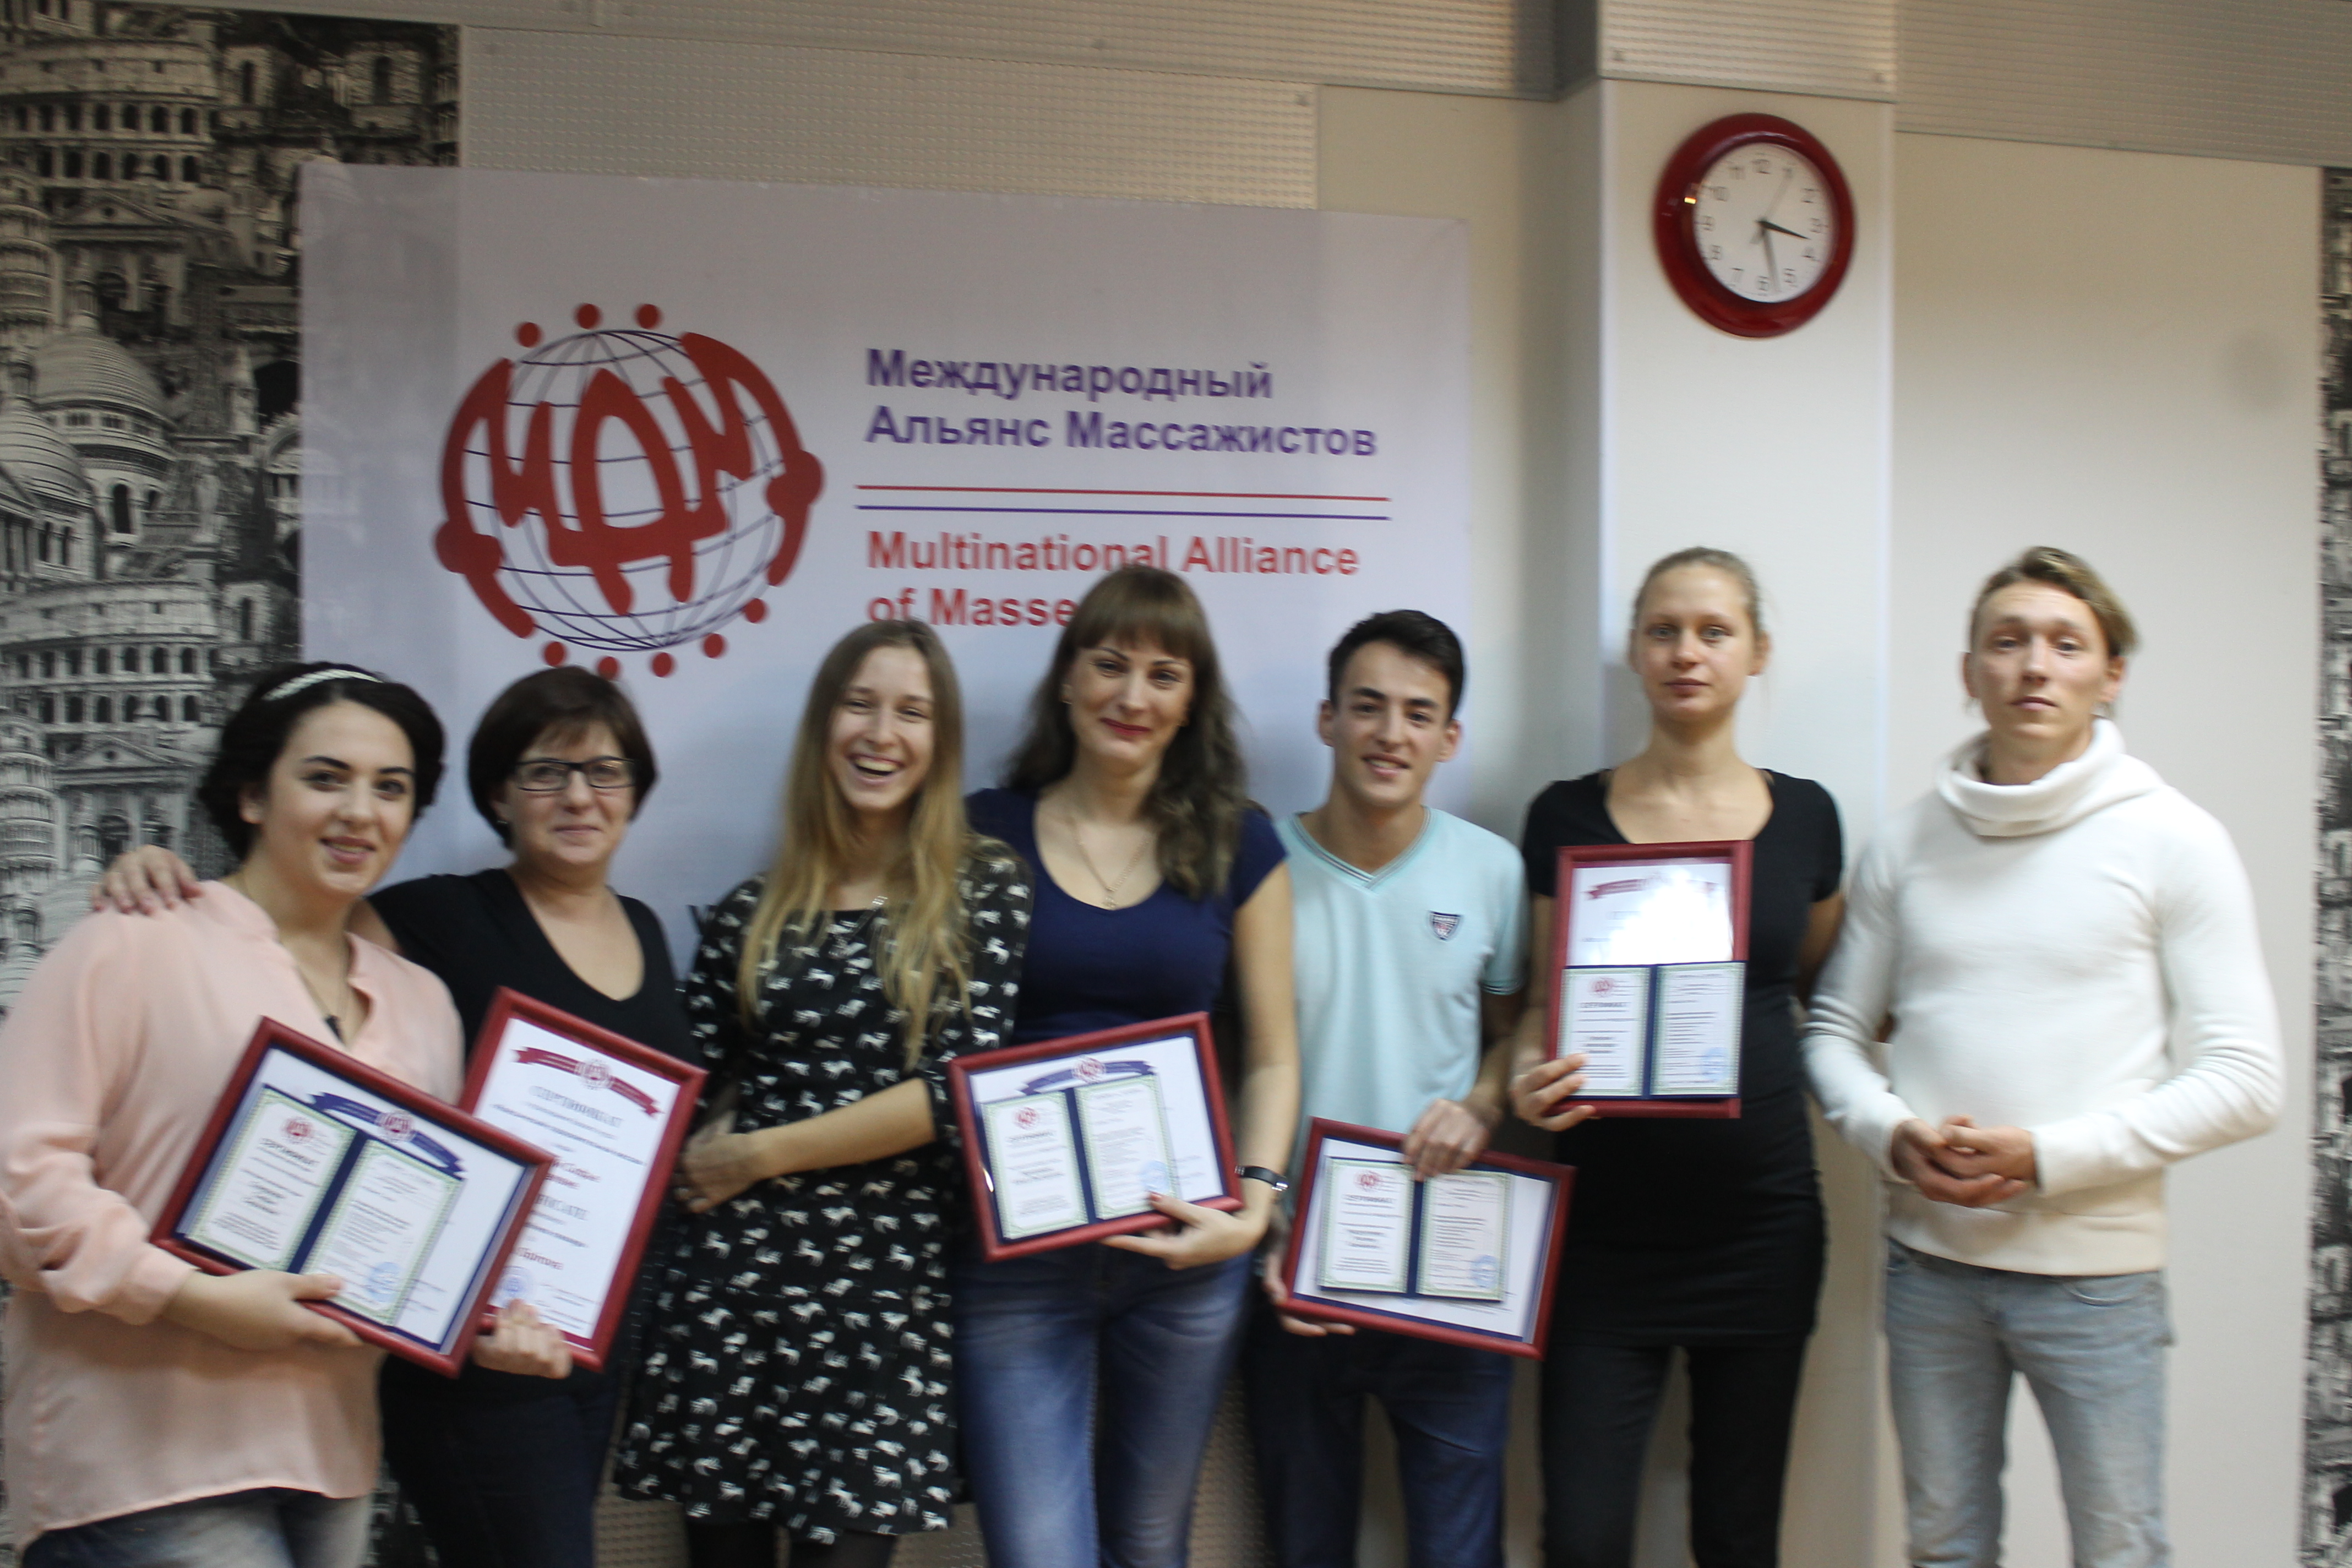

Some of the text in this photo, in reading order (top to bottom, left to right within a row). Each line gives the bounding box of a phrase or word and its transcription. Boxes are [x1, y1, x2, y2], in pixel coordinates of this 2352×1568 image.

[867, 348, 1272, 402] Международный
[866, 405, 1378, 457] Альянс Массажистов
[867, 529, 1359, 575] Multinational Alliance
[867, 586, 915, 623] of
